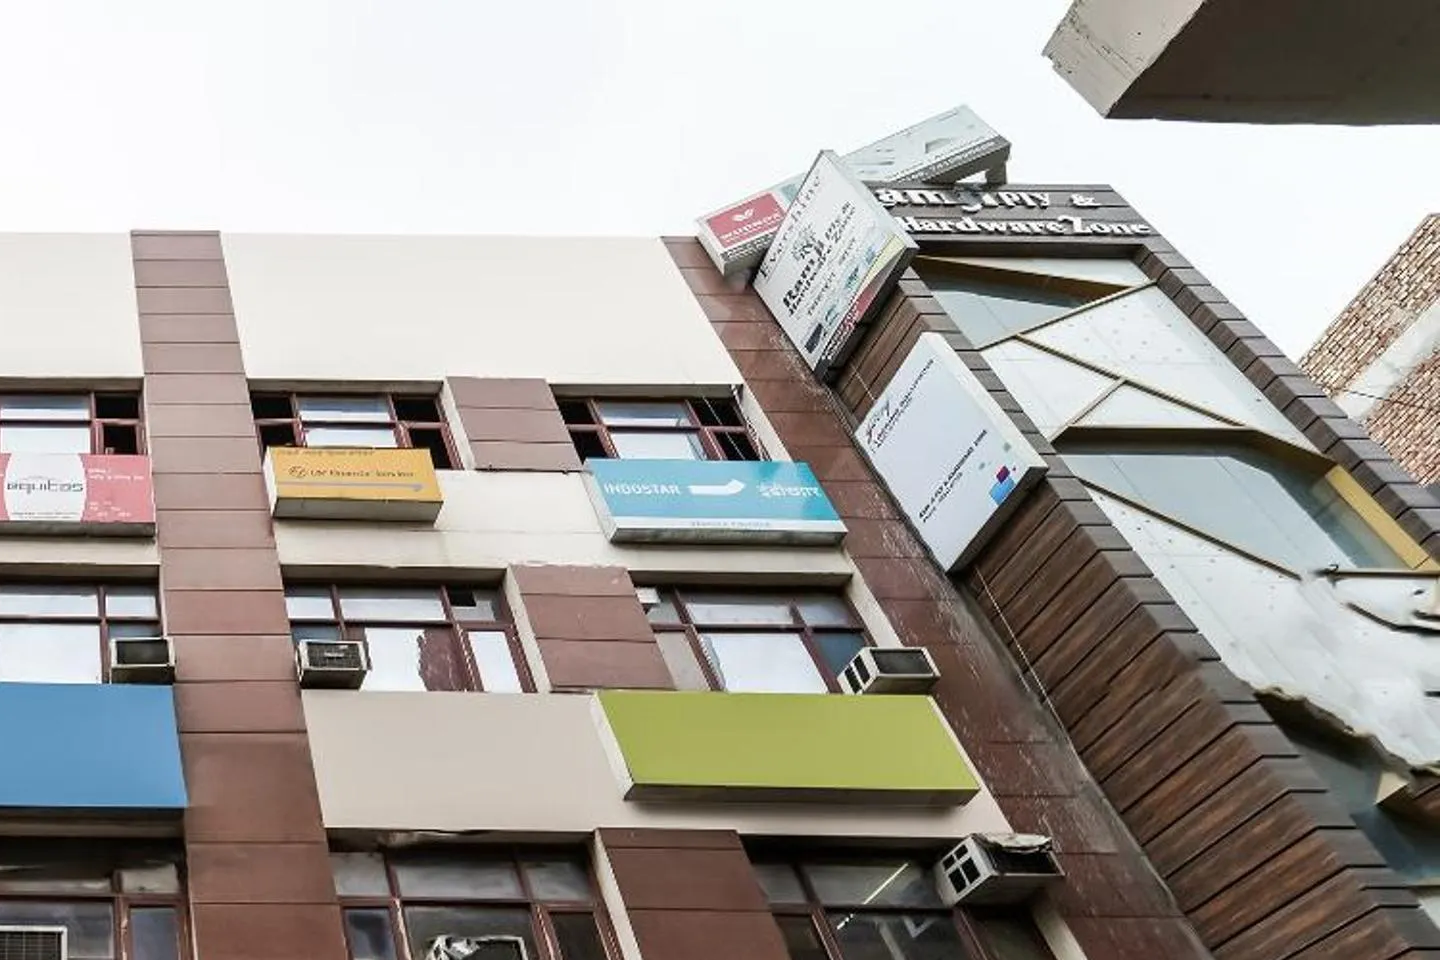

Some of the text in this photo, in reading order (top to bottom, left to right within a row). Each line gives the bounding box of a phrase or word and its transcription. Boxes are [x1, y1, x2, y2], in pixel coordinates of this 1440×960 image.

[995, 191, 1049, 209] Ply
[1070, 194, 1102, 207] &
[1058, 215, 1150, 235] Zone
